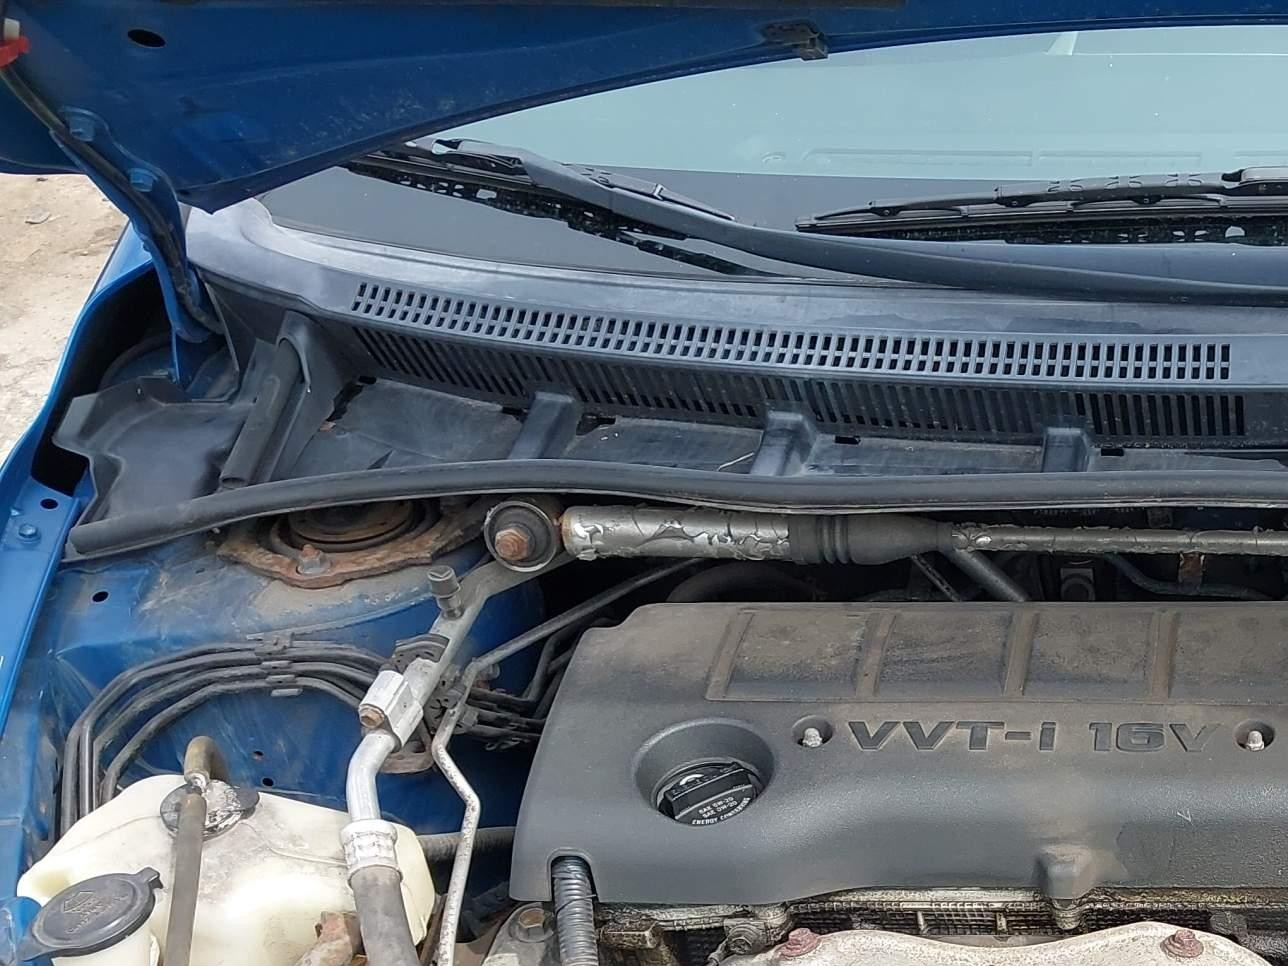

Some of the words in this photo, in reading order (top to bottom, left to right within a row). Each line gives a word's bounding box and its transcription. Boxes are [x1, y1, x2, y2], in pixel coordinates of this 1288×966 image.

[1089, 721, 1221, 753] 16V
[698, 805, 712, 814] SAE
[702, 809, 716, 819] SAE
[691, 817, 718, 825] ENERGY
